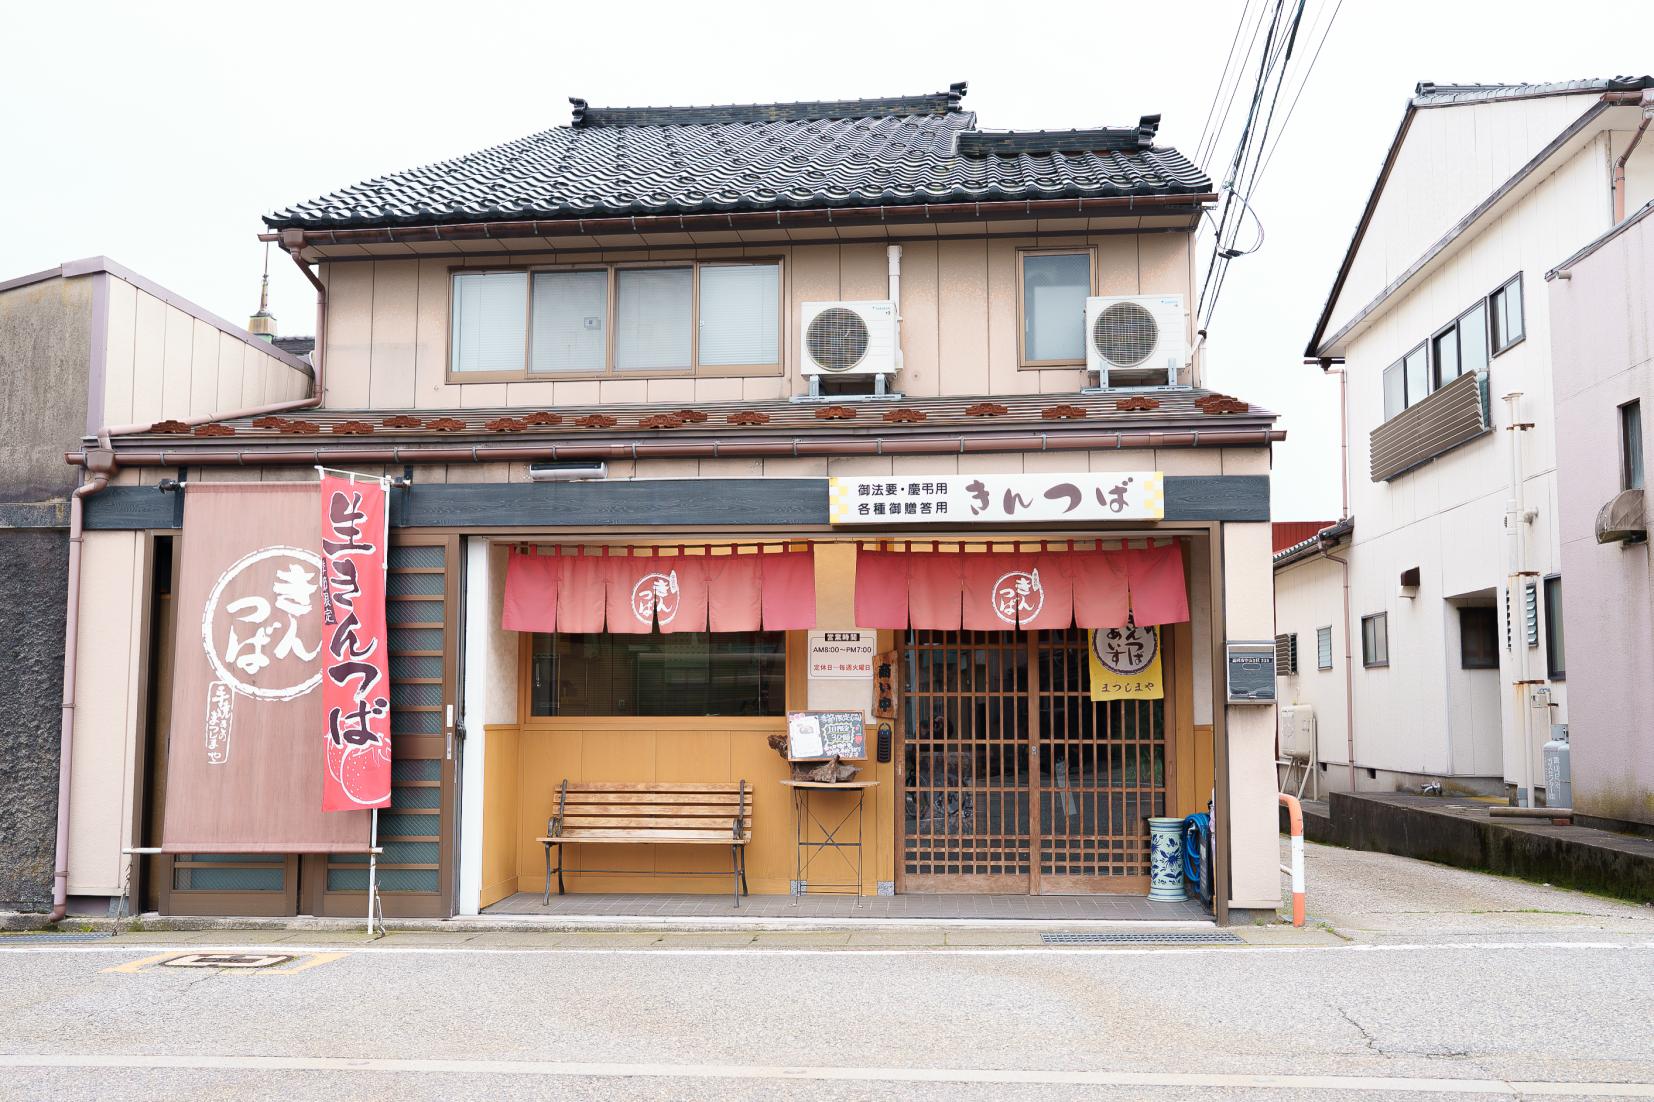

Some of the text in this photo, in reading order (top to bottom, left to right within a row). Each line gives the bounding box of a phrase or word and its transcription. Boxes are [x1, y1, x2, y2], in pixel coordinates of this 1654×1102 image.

[858, 483, 948, 496] 御法要・慶弔用
[965, 477, 1134, 515] きんつば
[857, 501, 948, 515] 各種御贈答用
[321, 490, 390, 747] 生きんつば
[826, 633, 858, 641] 営業時間
[1125, 607, 1144, 666] んつば
